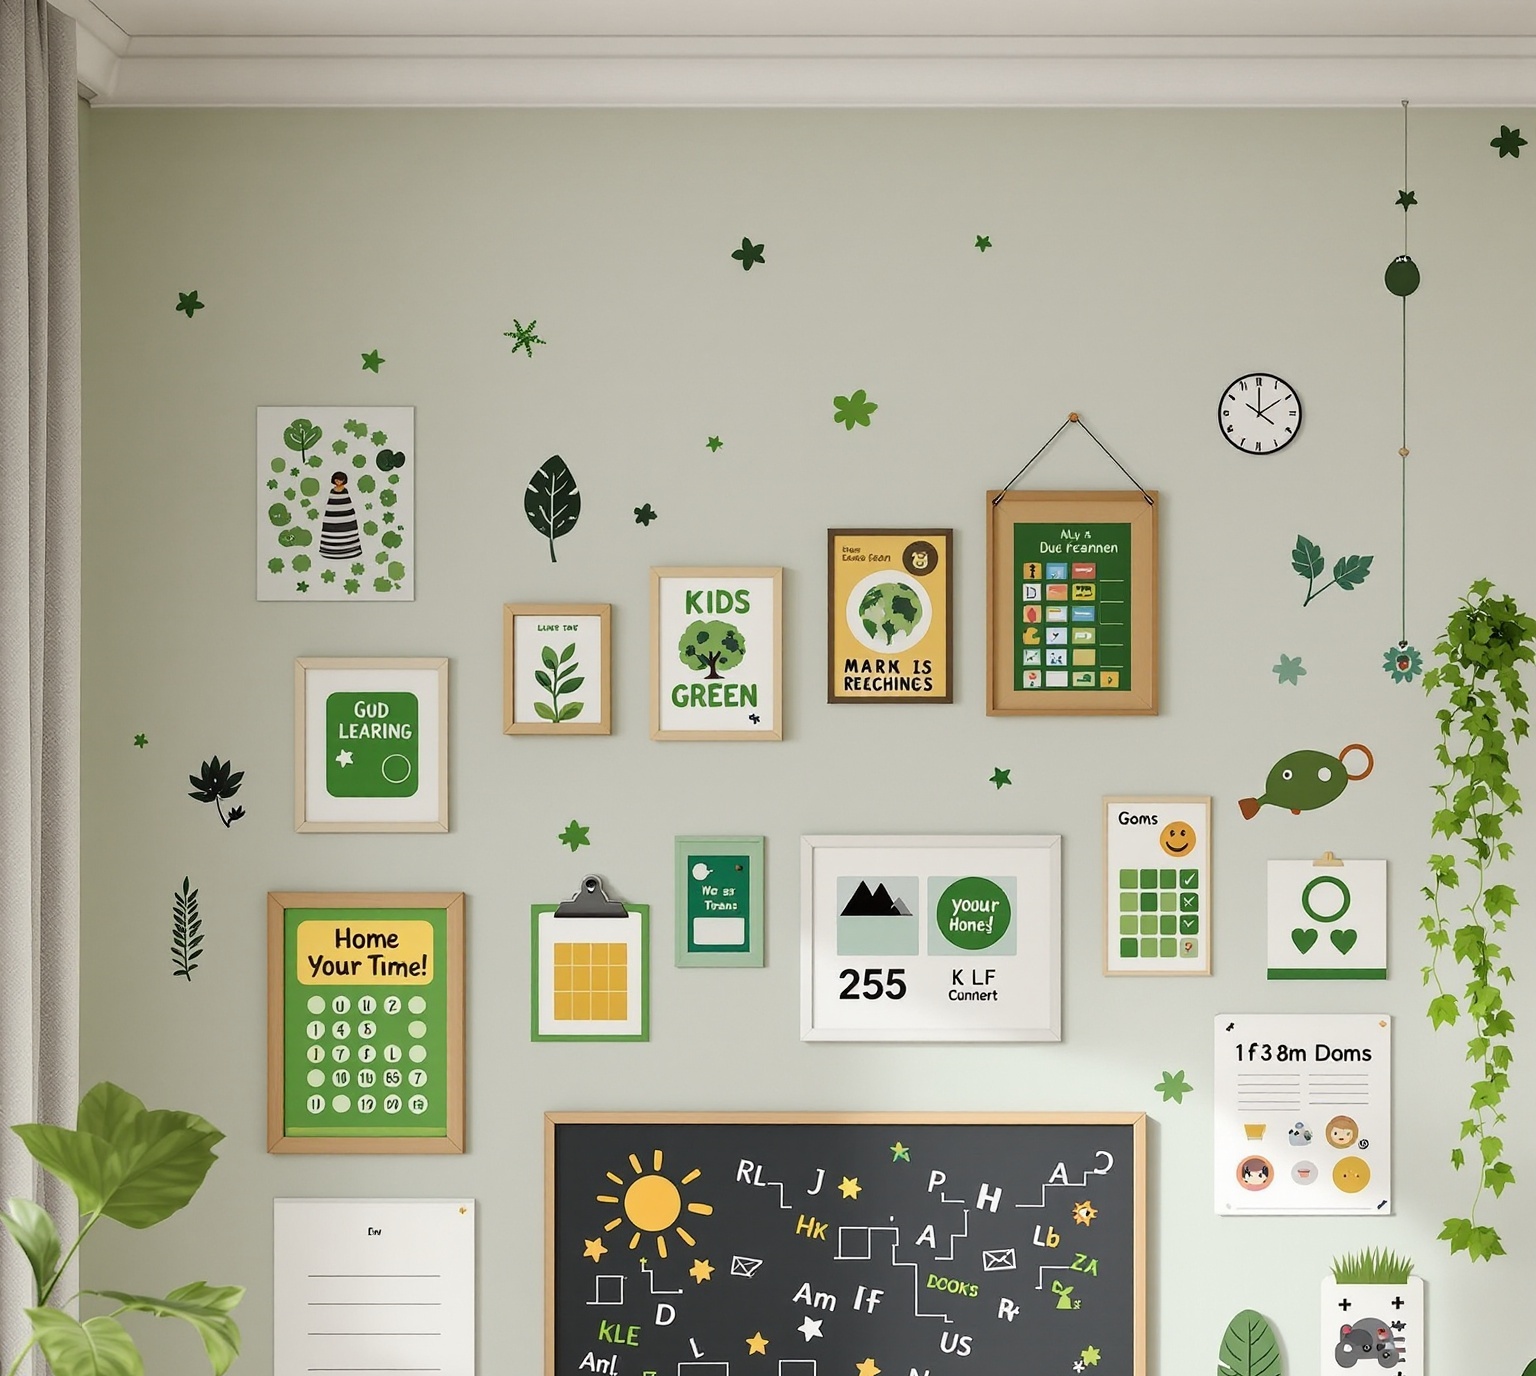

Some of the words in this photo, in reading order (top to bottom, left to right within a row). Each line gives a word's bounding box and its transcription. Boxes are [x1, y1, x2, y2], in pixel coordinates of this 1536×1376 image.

[685, 589, 751, 615] KIDS
[913, 660, 932, 675] IS
[670, 683, 758, 708] GREEN
[354, 700, 389, 719] GUD
[338, 723, 412, 740] LEARING
[1118, 811, 1158, 826] Goms
[335, 927, 399, 949] Home
[308, 954, 362, 978] Your
[367, 953, 428, 978] Time!
[839, 968, 907, 1000] 255
[952, 969, 964, 985] K
[972, 969, 996, 986] LF
[1315, 1044, 1372, 1062] Doms
[806, 1168, 826, 1195] J
[927, 1169, 947, 1193] P
[976, 1183, 1003, 1213] H
[915, 1224, 936, 1249] A
[792, 1282, 837, 1312] Am
[655, 1303, 676, 1326] D
[598, 1319, 641, 1346] KLE
[940, 1331, 973, 1357] US
